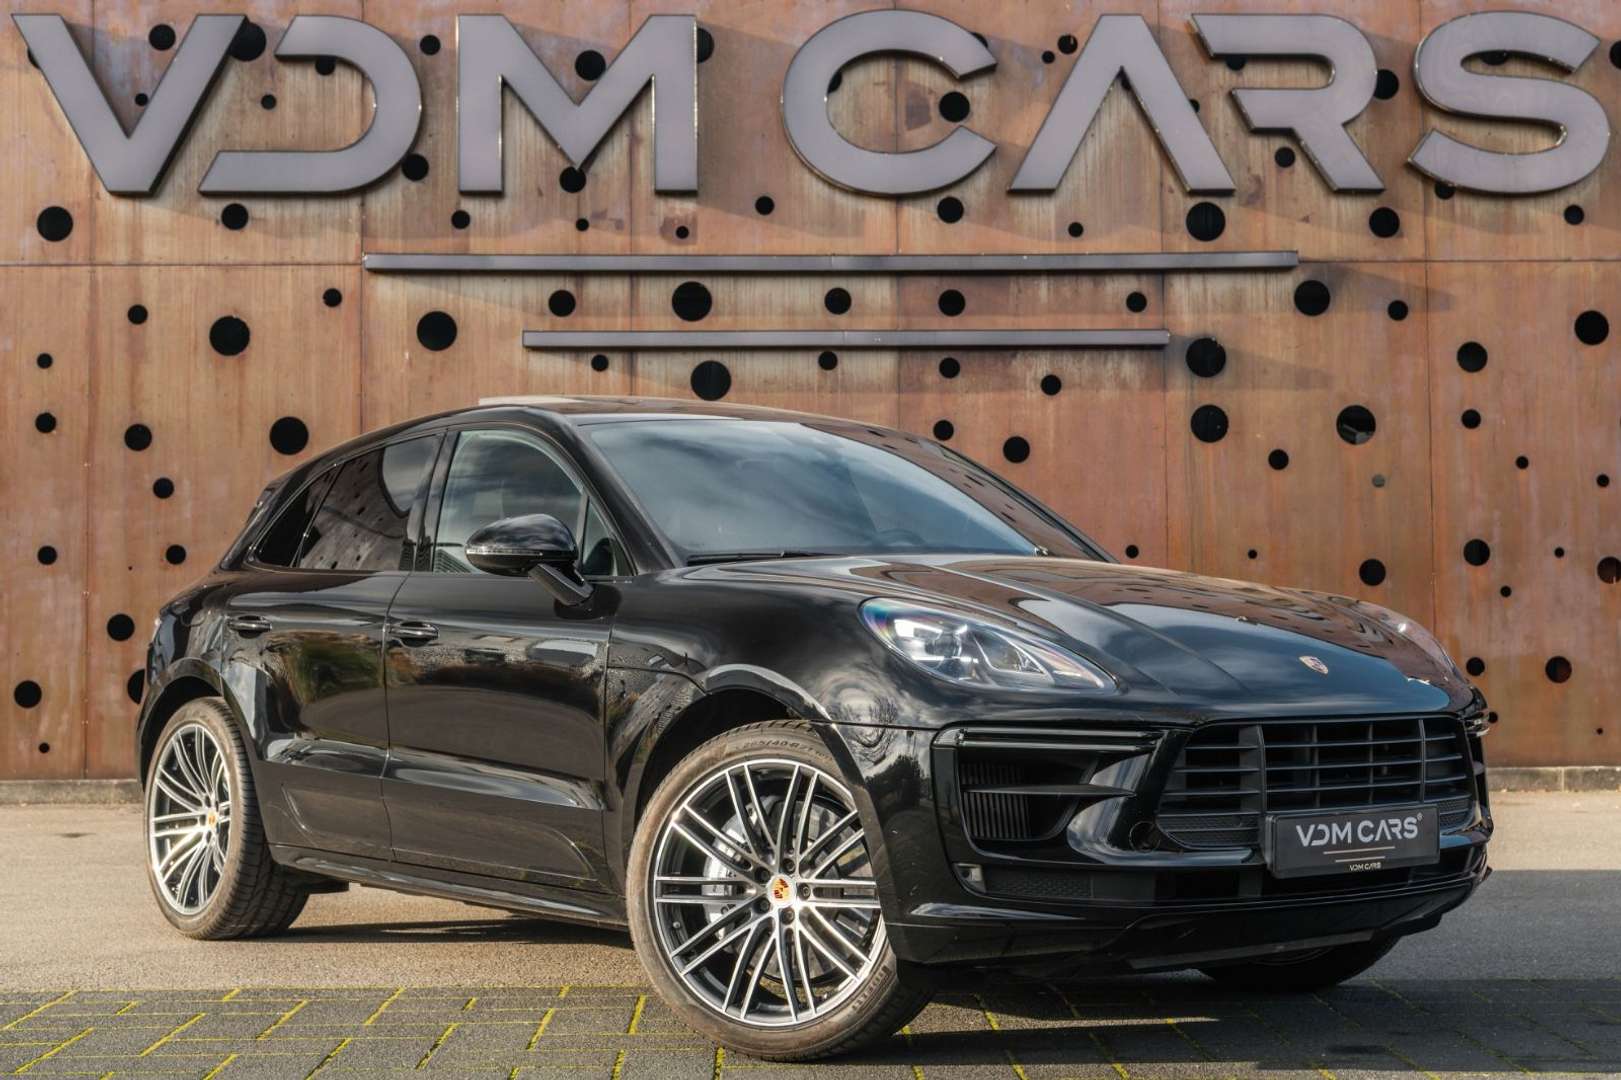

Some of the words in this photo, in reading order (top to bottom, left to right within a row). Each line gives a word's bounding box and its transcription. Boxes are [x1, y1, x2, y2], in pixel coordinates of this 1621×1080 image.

[12, 14, 698, 194] VDM
[783, 9, 1611, 196] CARS
[1296, 821, 1352, 847] VDM
